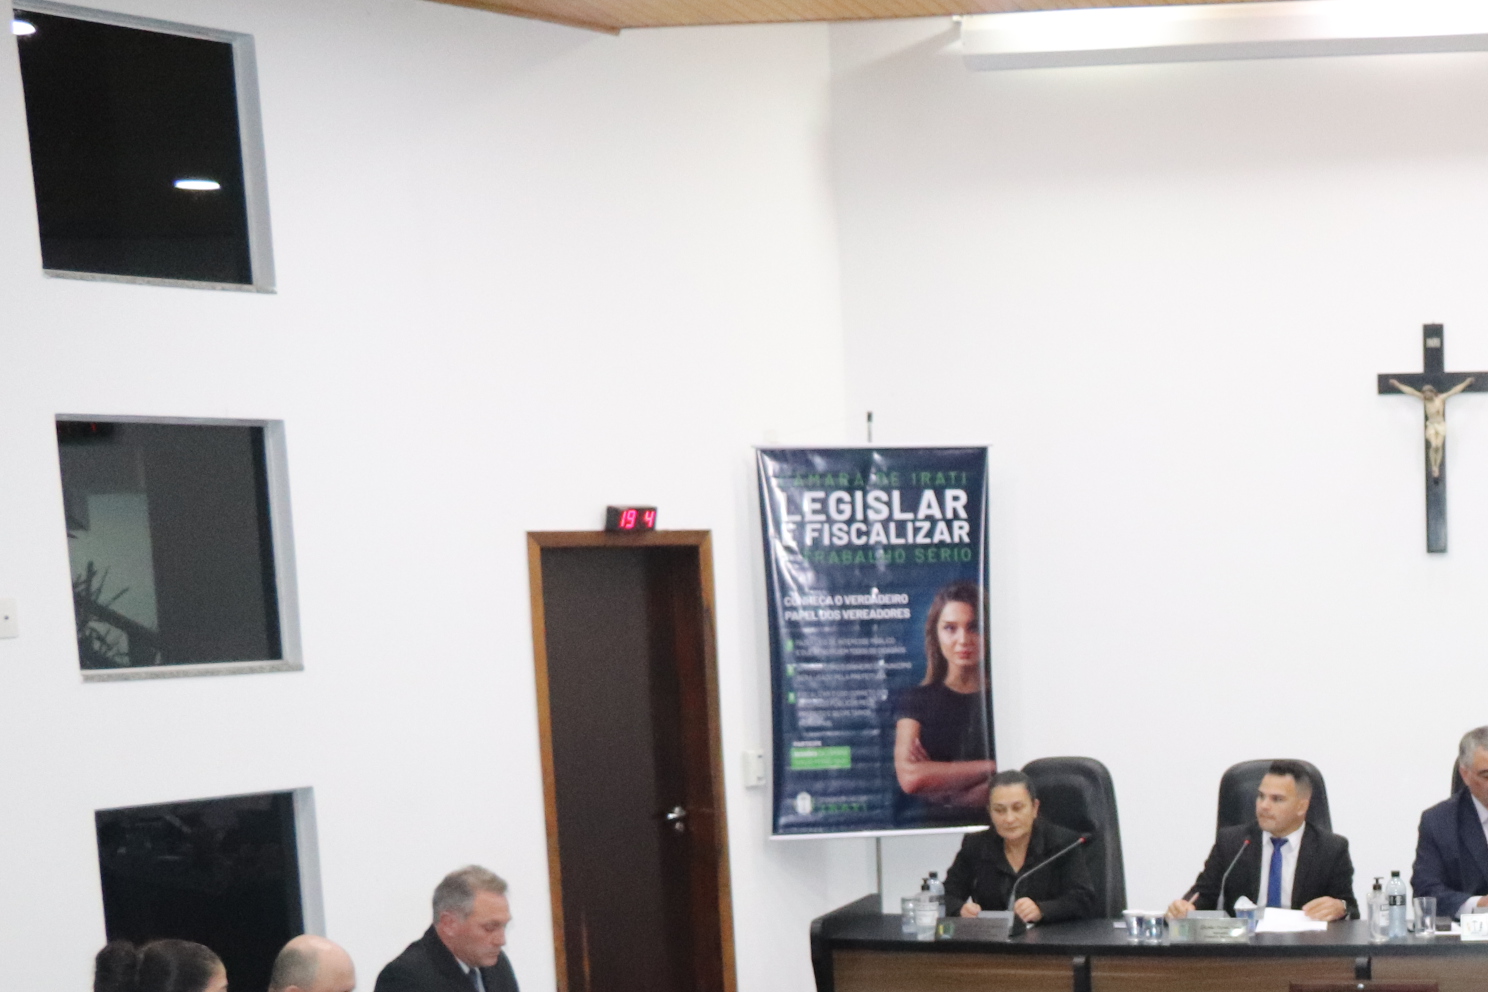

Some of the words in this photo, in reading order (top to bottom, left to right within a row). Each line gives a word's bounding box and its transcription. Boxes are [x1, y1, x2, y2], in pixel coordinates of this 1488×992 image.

[911, 470, 968, 486] IRATI
[781, 488, 969, 522] LEGISLAR
[804, 520, 971, 546] FISCALIZAR
[843, 593, 909, 606] VERDADEIRO
[785, 609, 819, 621] PAPEL
[819, 608, 841, 620] DOS
[842, 607, 911, 620] VEREADORES
